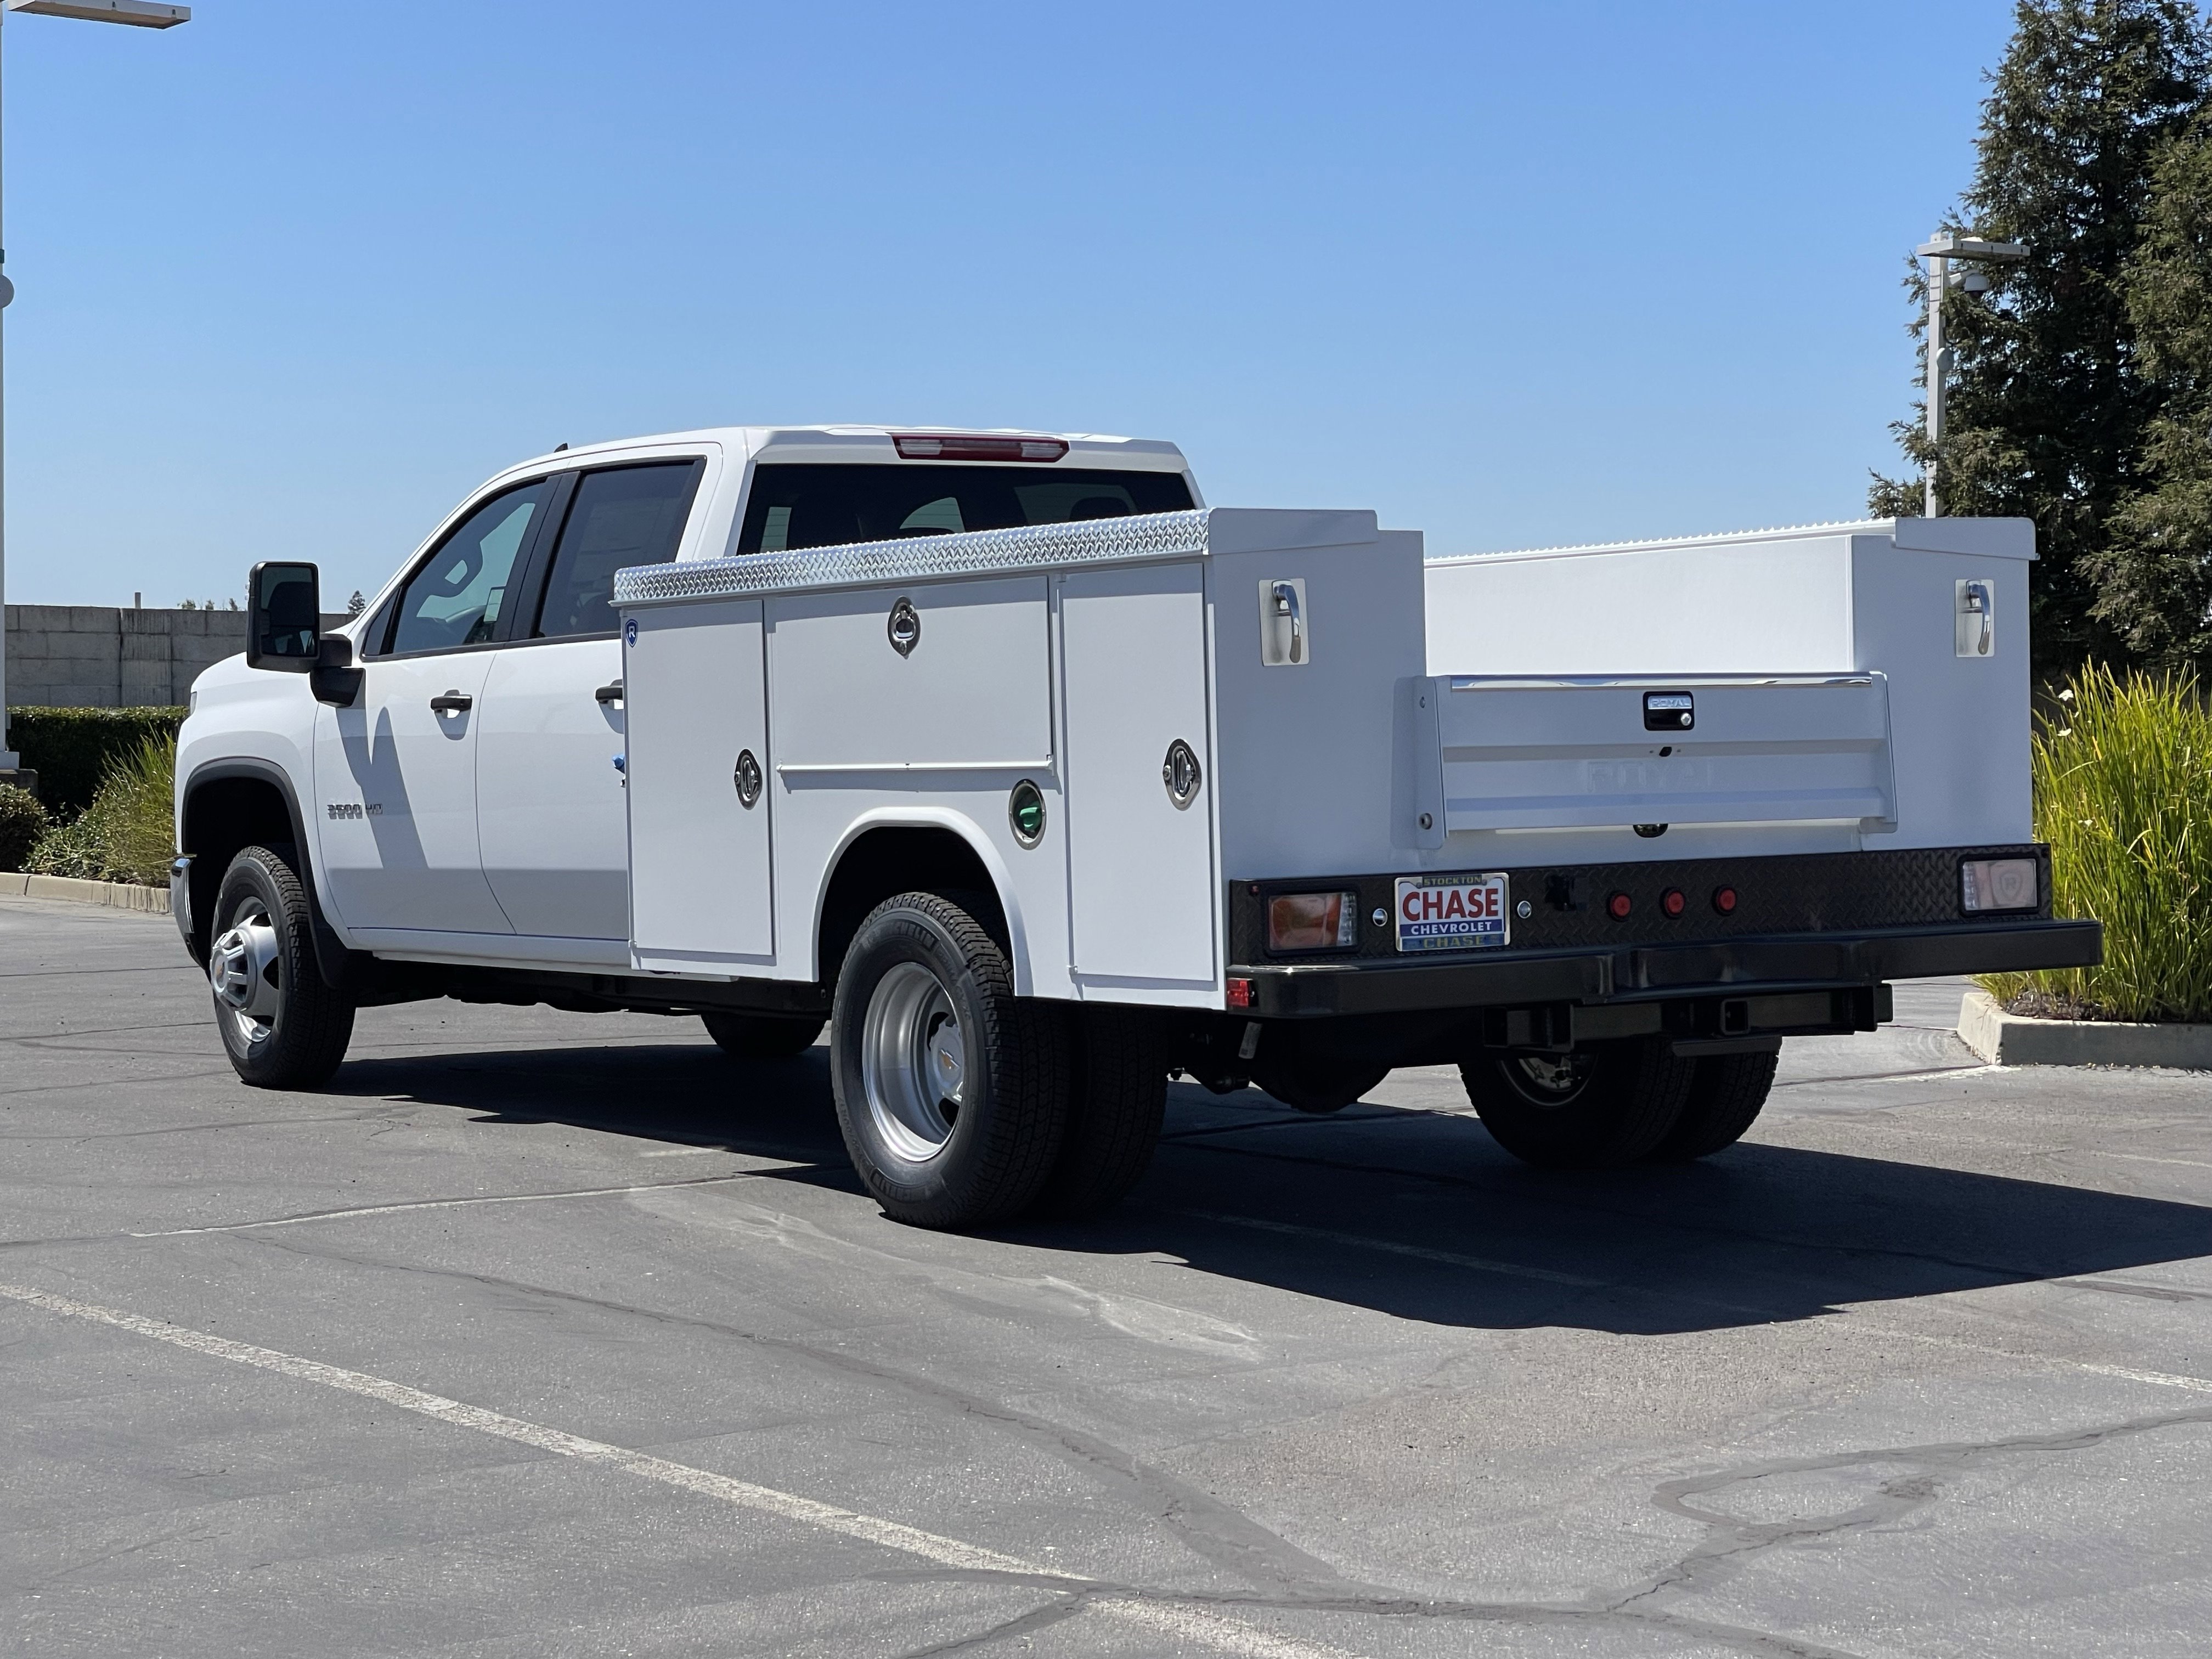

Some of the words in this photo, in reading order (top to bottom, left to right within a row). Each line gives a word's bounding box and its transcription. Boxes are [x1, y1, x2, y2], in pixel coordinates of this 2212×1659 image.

[628, 625, 636, 638] R
[1424, 876, 1481, 886] STOCKTON
[1402, 888, 1499, 922] CHASE
[1410, 921, 1492, 935] CHEVROLET
[1423, 935, 1485, 949] CHASE
